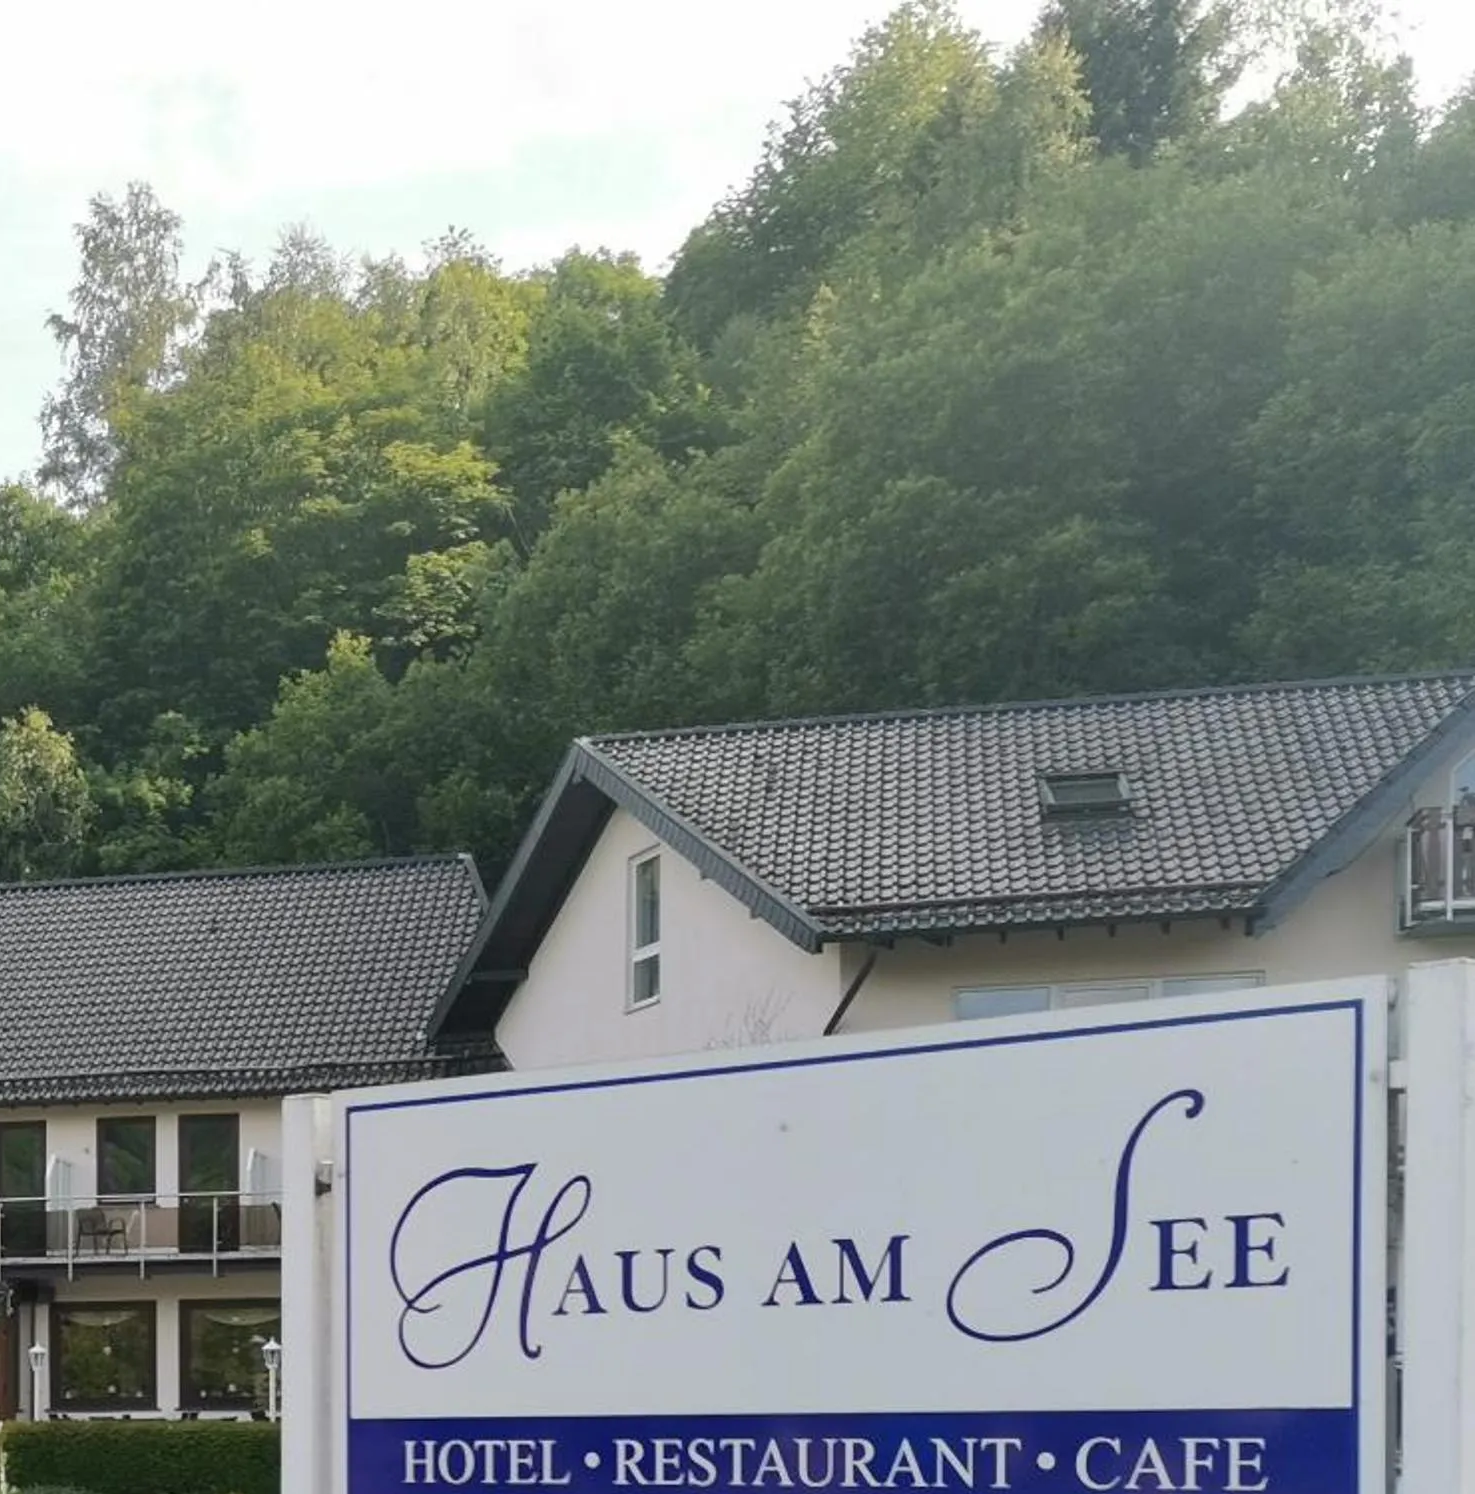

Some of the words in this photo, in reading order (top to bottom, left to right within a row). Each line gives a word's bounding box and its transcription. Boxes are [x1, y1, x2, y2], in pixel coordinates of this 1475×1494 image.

[390, 1162, 726, 1368] HAUS
[761, 1234, 911, 1308] AM
[946, 1088, 1290, 1342] SEE
[403, 1438, 571, 1486] HOTEL
[613, 1437, 1024, 1490] RESTAURANT
[1074, 1436, 1269, 1492] CAFE
